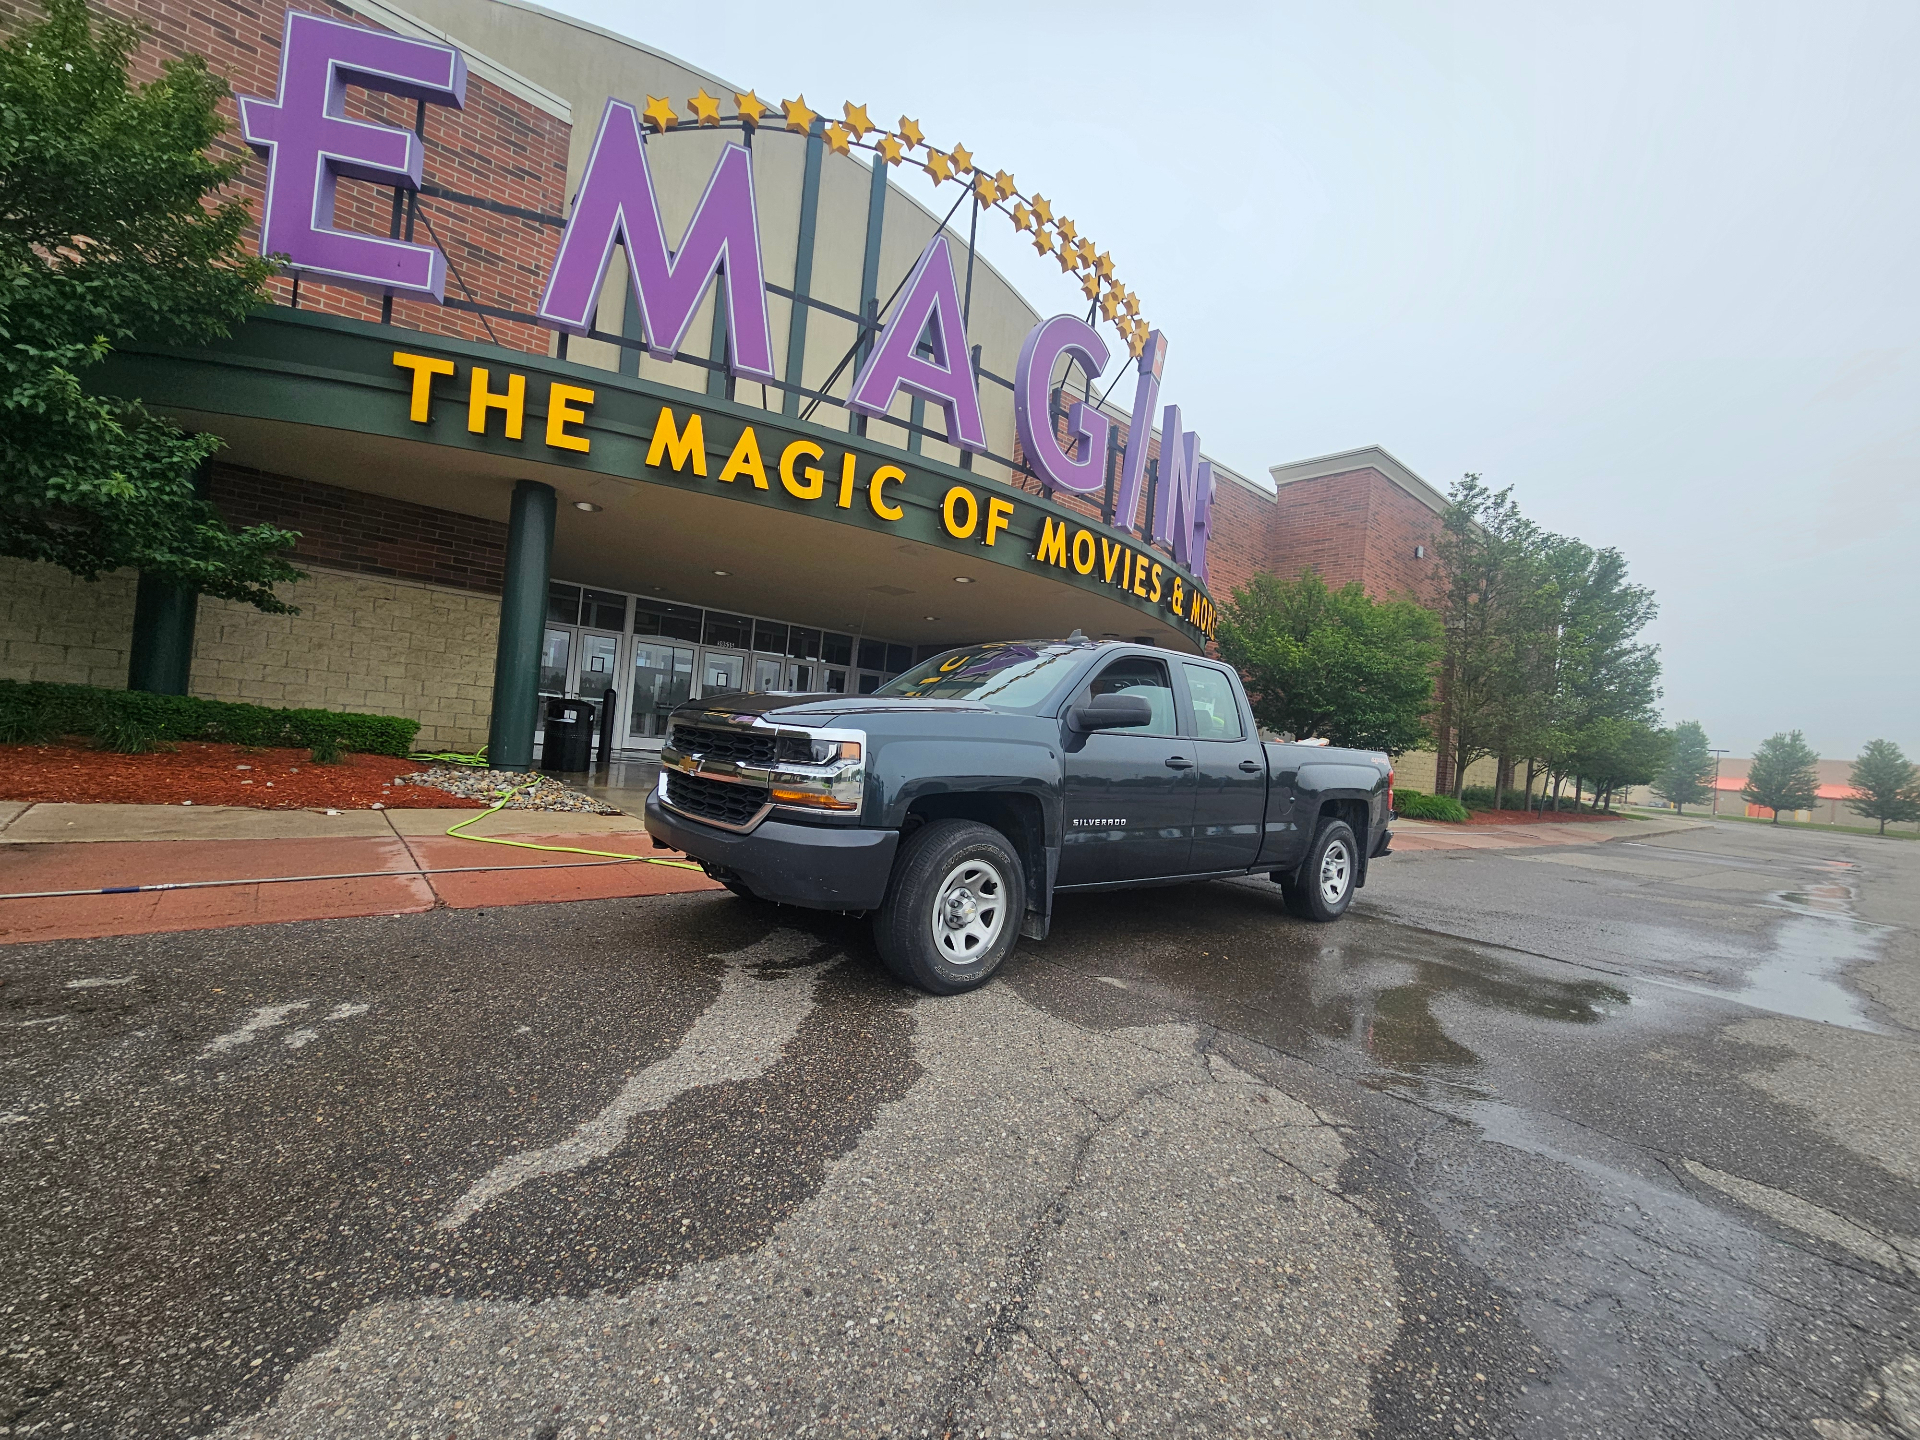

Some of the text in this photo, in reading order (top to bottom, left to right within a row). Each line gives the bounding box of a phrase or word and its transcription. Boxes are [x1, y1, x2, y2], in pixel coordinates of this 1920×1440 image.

[392, 350, 595, 454] THE
[645, 405, 907, 522] MAGIC
[942, 485, 1015, 547] OF
[1036, 516, 1163, 603] MOVIES
[1171, 576, 1184, 617] &
[1072, 818, 1127, 827] SILVERADO
